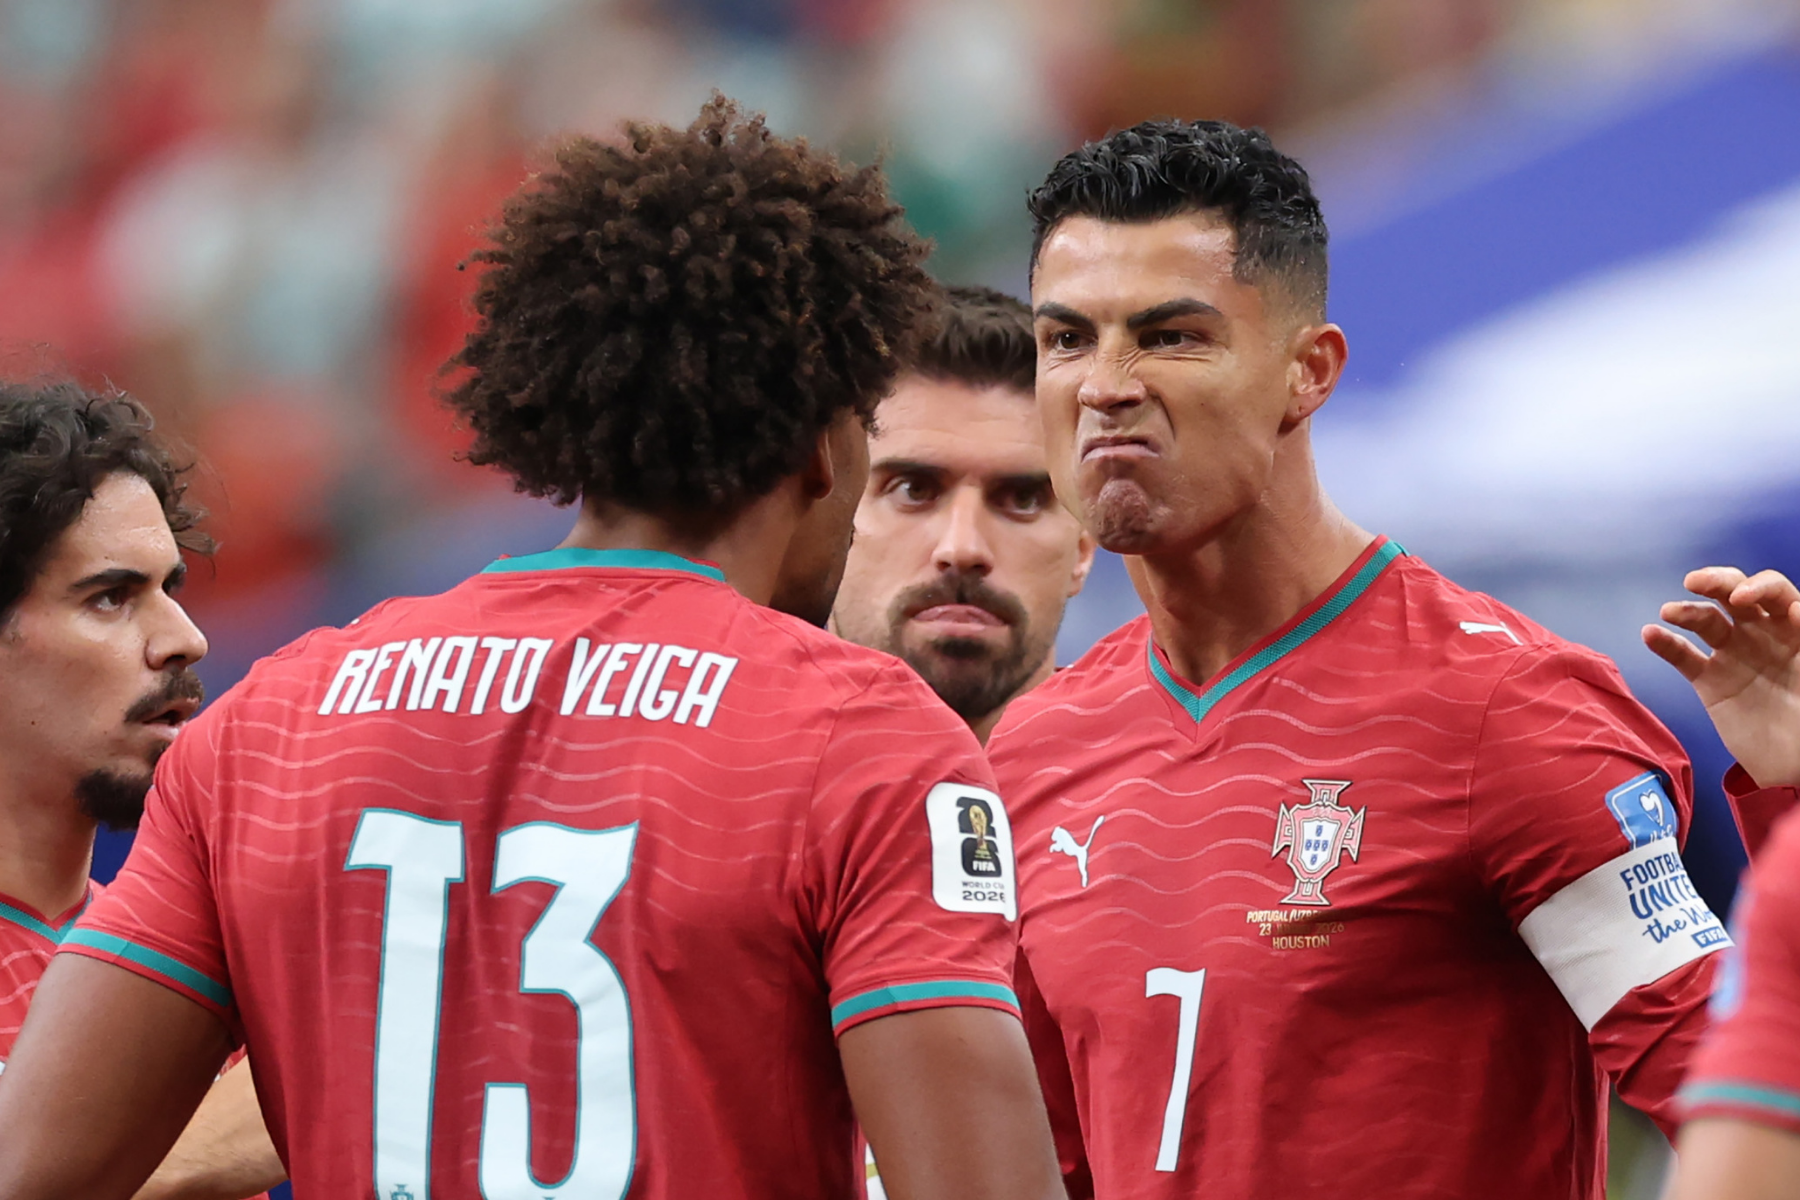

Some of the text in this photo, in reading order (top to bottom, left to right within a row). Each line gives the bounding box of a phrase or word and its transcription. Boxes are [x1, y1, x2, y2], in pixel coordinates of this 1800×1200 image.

[317, 636, 738, 727] RENATO VEIGA
[972, 860, 996, 872] FIFA
[1620, 852, 1684, 891] FOOTBA
[962, 881, 991, 890] WORLD
[1629, 874, 1697, 919] UNITE
[1259, 923, 1271, 936] 23
[1272, 935, 1330, 949] HOUSTON
[1642, 918, 1687, 943] the
[344, 807, 639, 1200] 13
[1145, 966, 1206, 1172] 7
